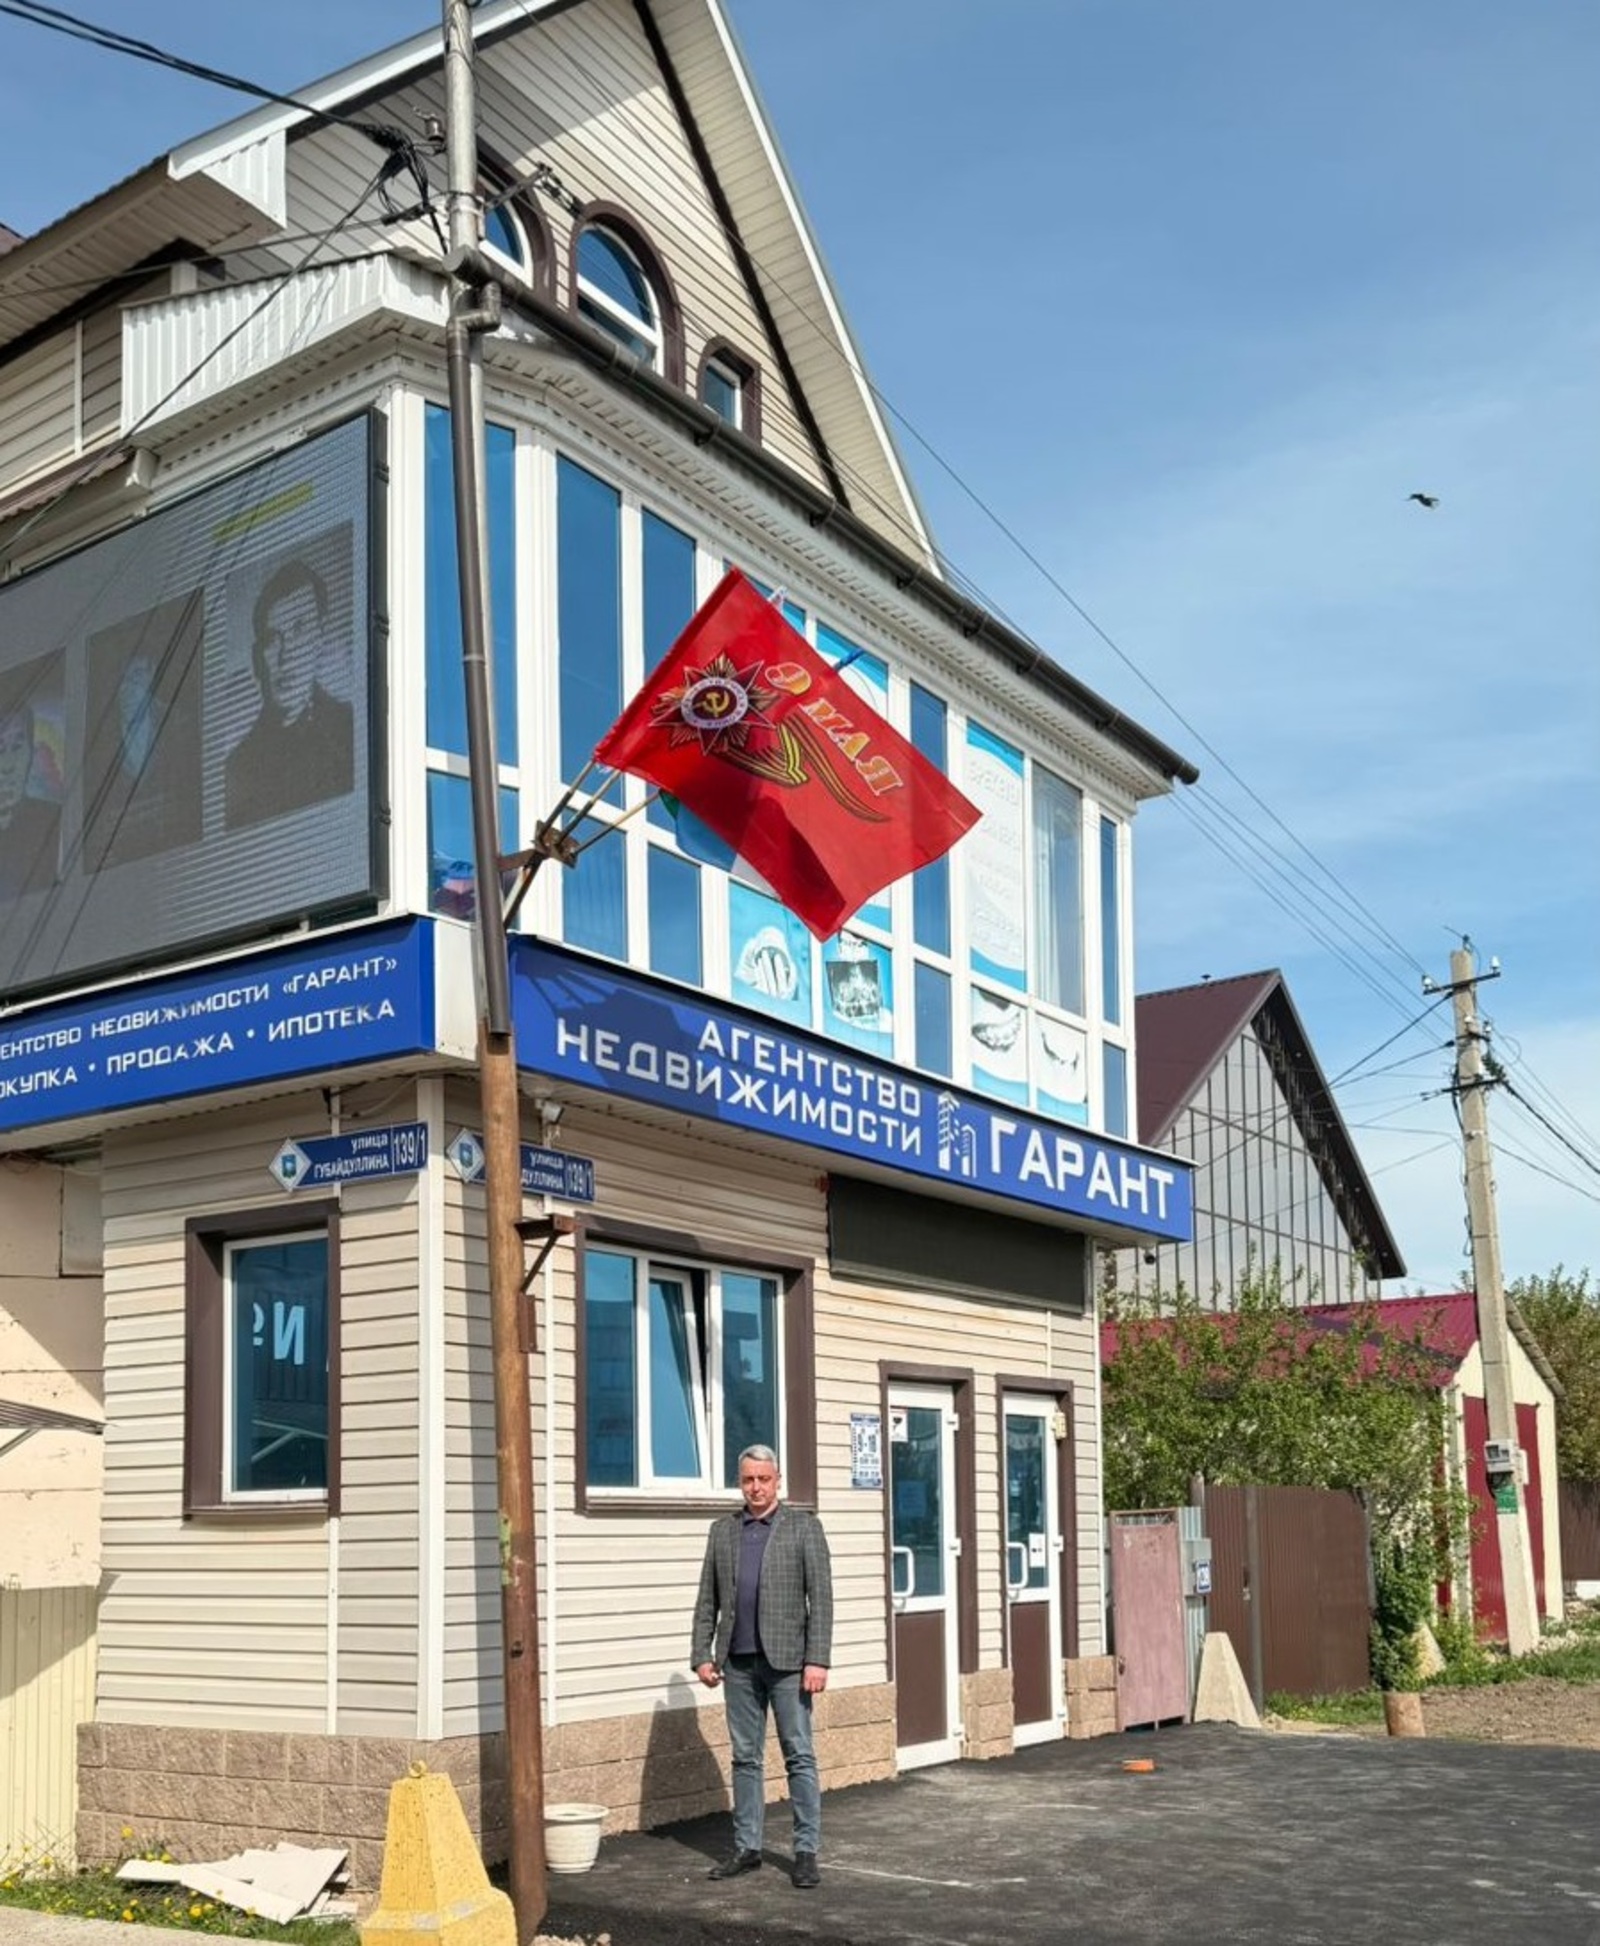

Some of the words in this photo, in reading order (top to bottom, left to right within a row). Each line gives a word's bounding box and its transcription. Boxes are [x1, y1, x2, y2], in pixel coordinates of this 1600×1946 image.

[764, 661, 812, 695] 9
[1, 1026, 82, 1060] ЕНТСТВО
[91, 983, 270, 1039] НЕДВИЖИМОСТИ
[282, 956, 397, 995] «ГАРАНТ»
[106, 1031, 235, 1076] ПРОДАЖА
[268, 998, 395, 1042] ИПОТЕКА
[556, 1017, 922, 1157] НЕДВИЖИМОСТИ
[697, 1019, 921, 1118] АГЕНТСТВО
[313, 1154, 390, 1179] ГУБАЙДУЛЛИНА
[351, 1134, 388, 1154] улица
[393, 1129, 426, 1166] 139/1
[990, 1116, 1175, 1220] ГАРАНТ
[522, 1167, 564, 1190] ДУЛЛИНА
